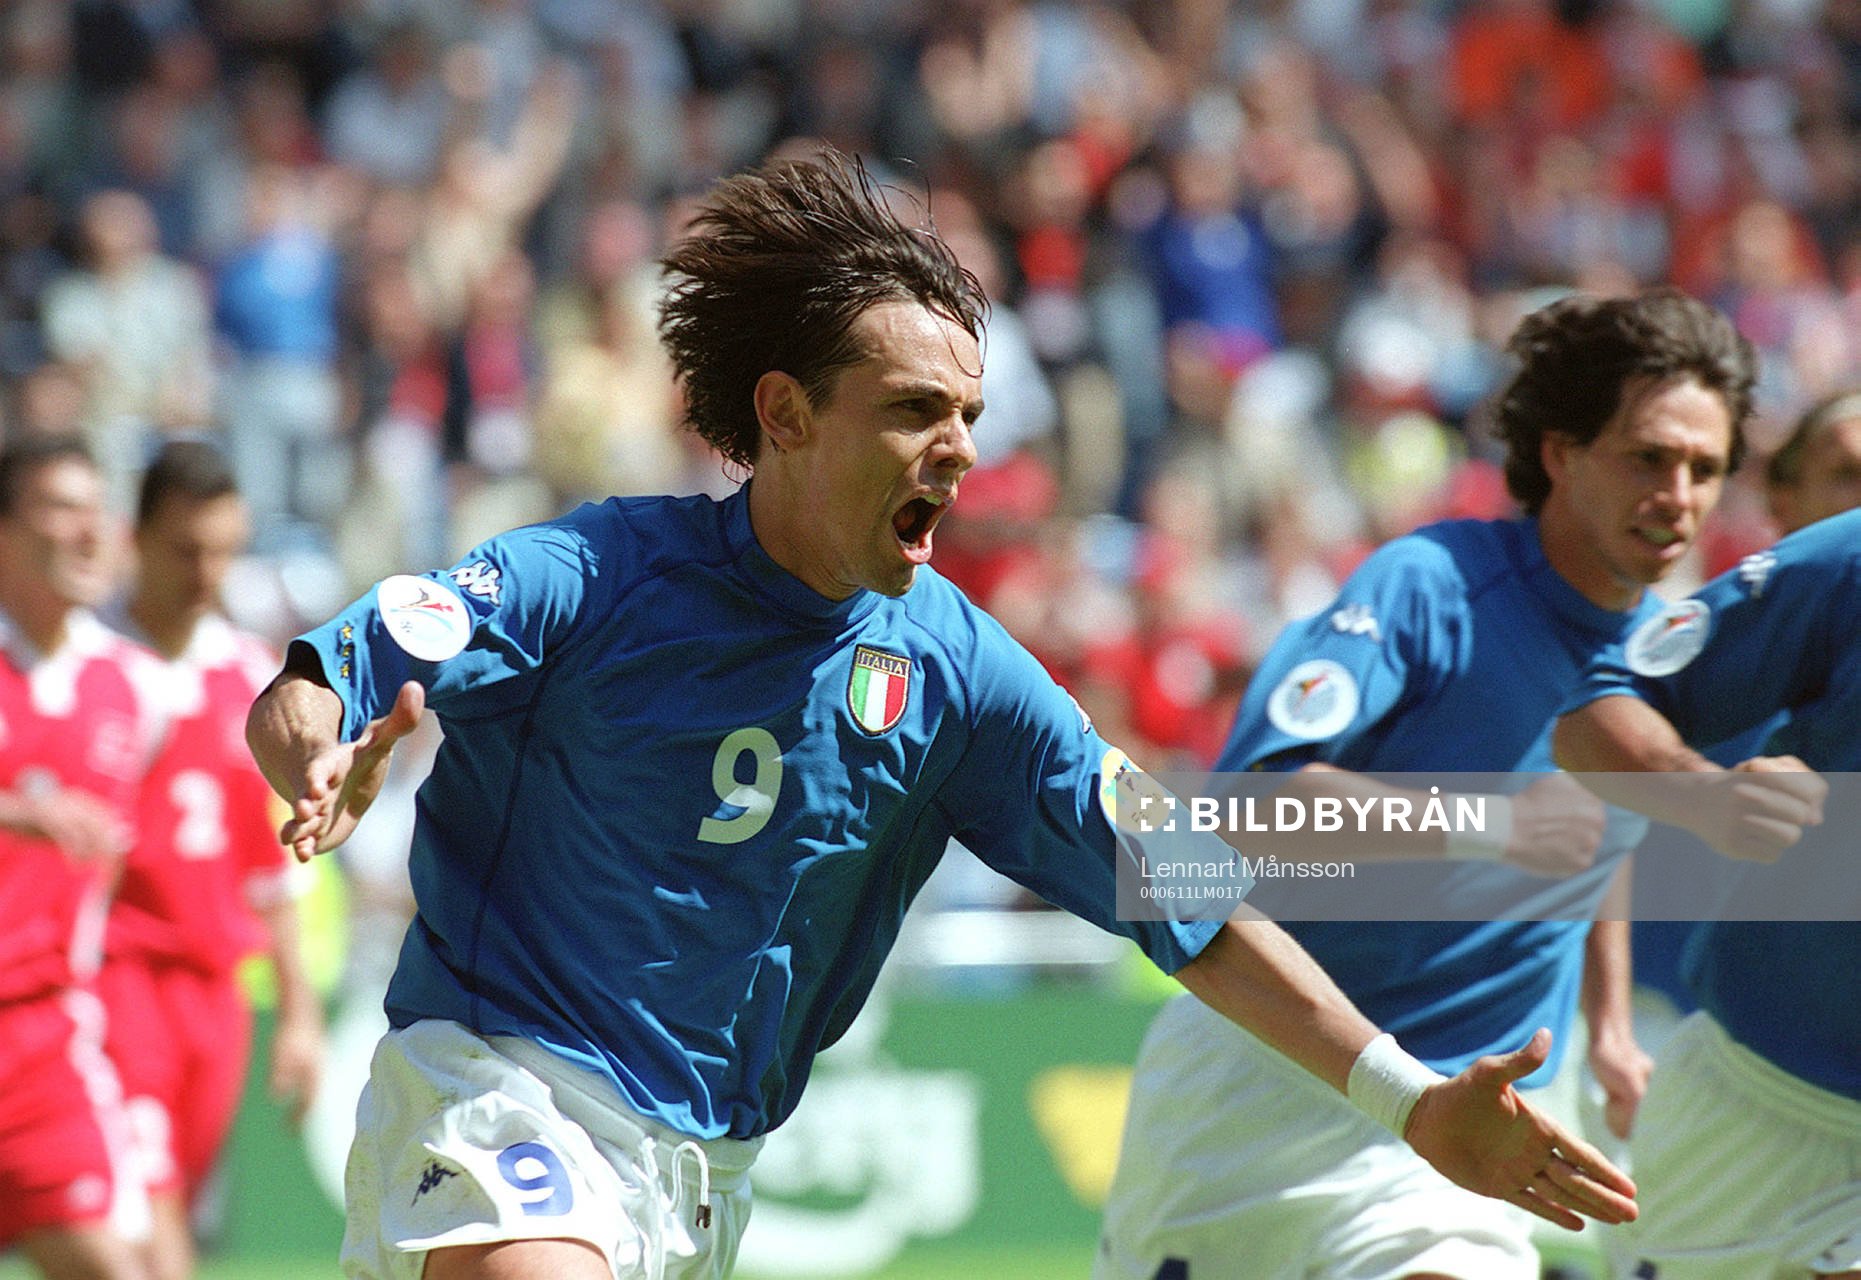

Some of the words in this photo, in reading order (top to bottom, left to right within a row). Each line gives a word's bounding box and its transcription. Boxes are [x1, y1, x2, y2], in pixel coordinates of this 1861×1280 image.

[860, 652, 903, 674] ITALIA
[697, 727, 783, 844] 9
[497, 1142, 574, 1216] 9
